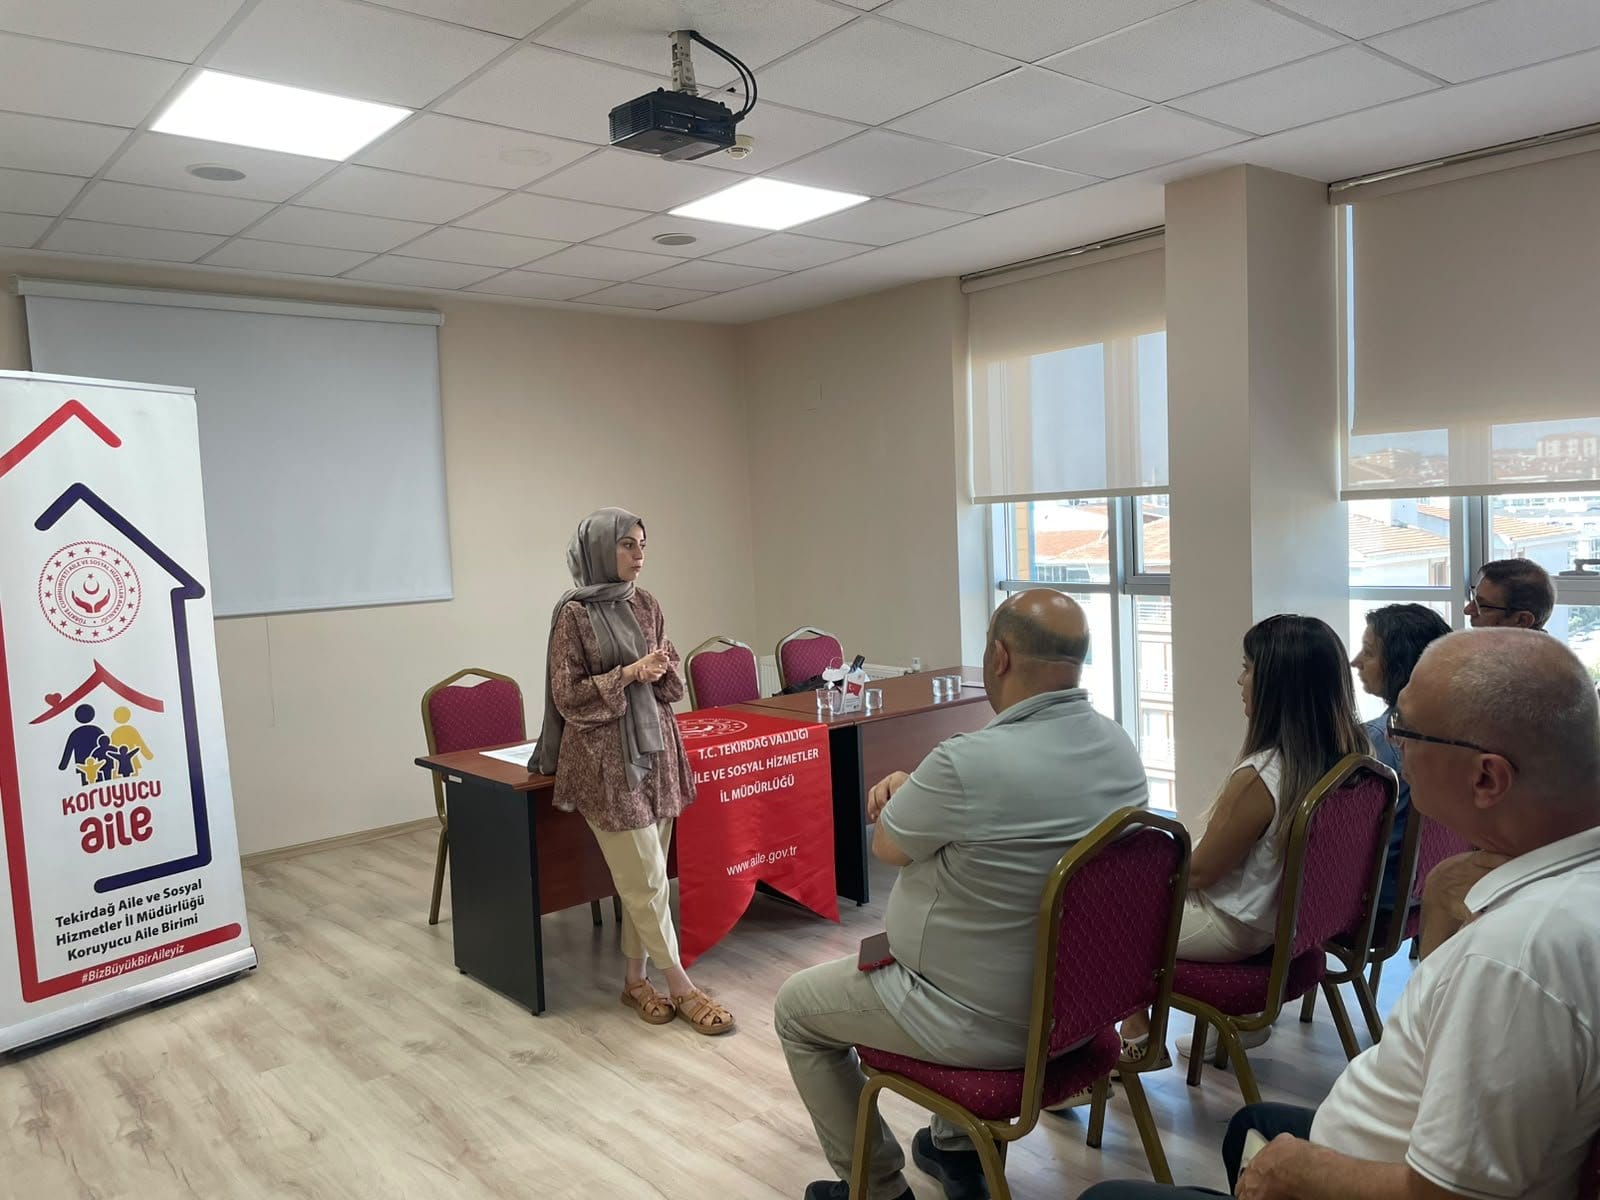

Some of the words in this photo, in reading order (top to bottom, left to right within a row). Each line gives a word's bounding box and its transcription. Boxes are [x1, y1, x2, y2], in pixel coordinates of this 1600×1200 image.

[693, 770, 710, 784] İLE
[711, 768, 726, 781] VE
[727, 760, 764, 778] SOSYAL
[766, 748, 819, 769] HİZMETLER
[698, 747, 717, 760] T.C.
[719, 790, 730, 803] İL
[731, 774, 795, 799] MÜDÜRLÜĞÜ
[80, 806, 153, 853] aile
[726, 845, 798, 876] www.aile.gov.tr
[55, 903, 116, 927] Tekirdağ
[119, 896, 143, 912] Aile
[145, 891, 160, 903] ve
[163, 879, 202, 899] Sosyal
[56, 919, 122, 946] Hizmetler
[125, 914, 134, 927] İl
[136, 895, 205, 924] Müdürlüğü
[67, 932, 132, 960] Koruyucu
[135, 926, 159, 941] Aile
[161, 913, 199, 934] Birimi
[81, 944, 185, 983] #BizBüyükBirAileyiz
